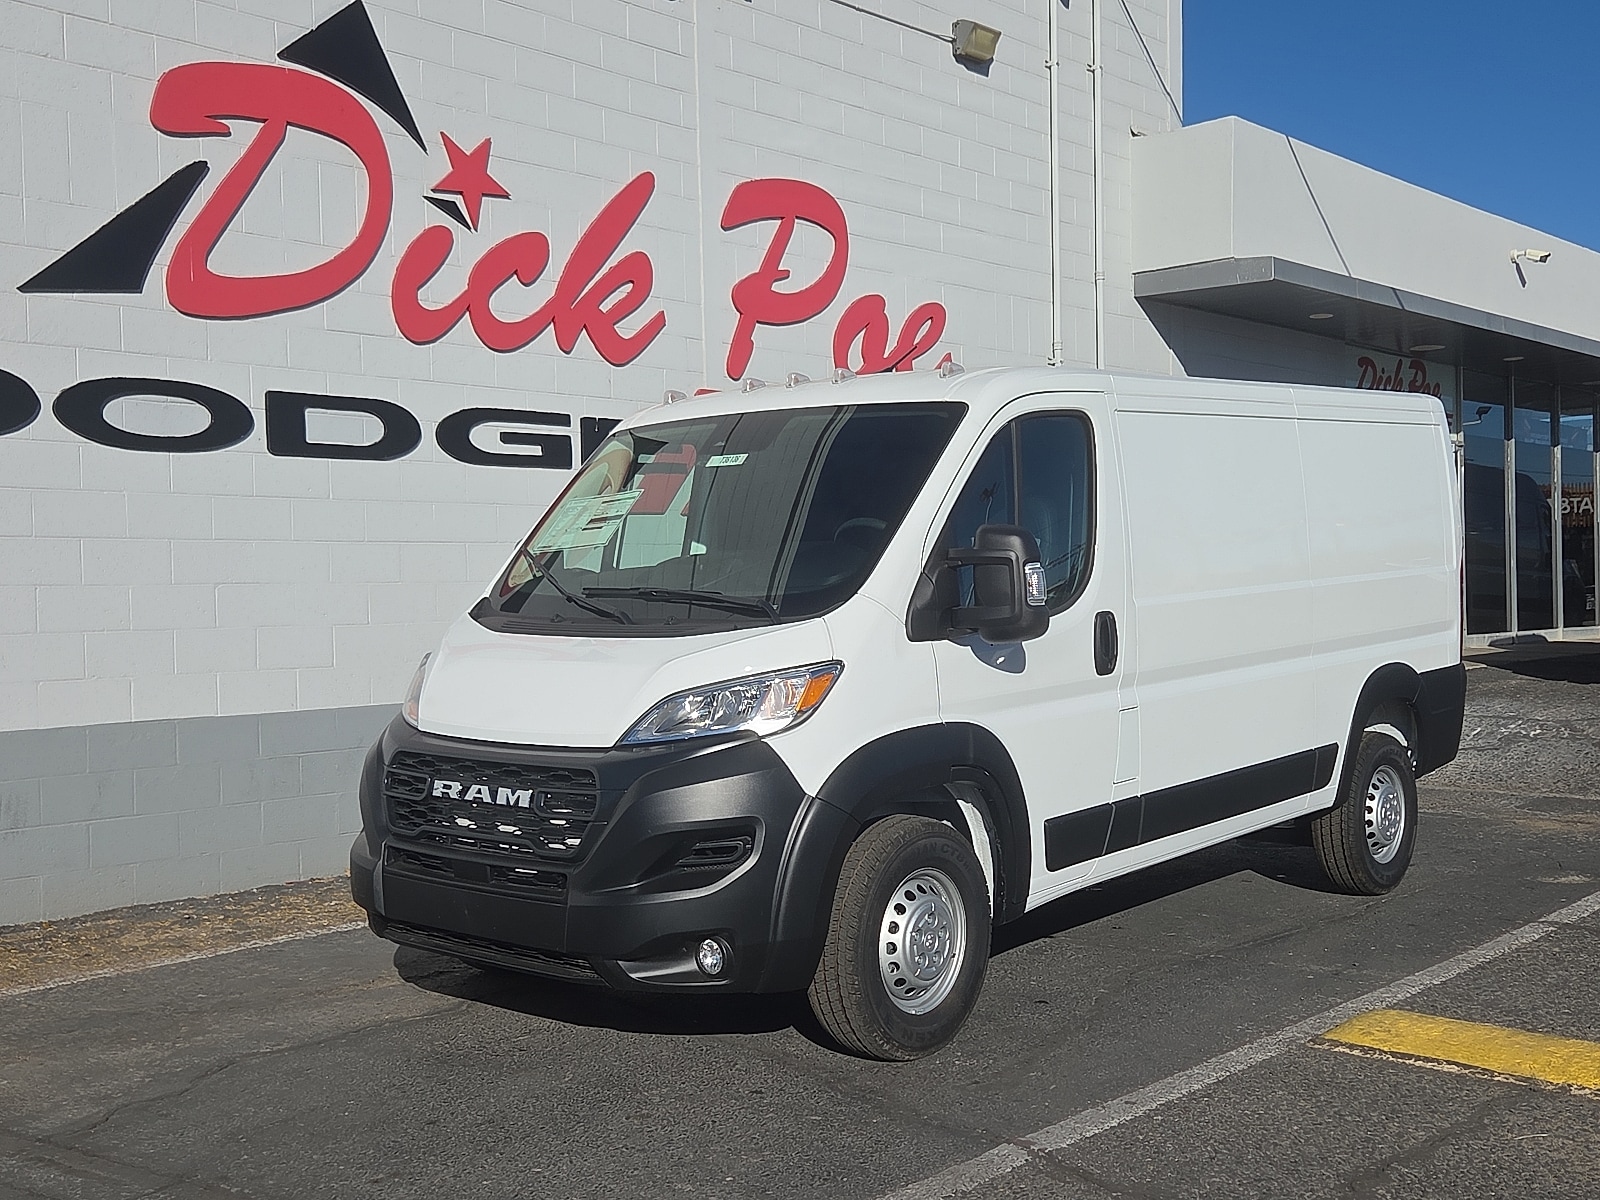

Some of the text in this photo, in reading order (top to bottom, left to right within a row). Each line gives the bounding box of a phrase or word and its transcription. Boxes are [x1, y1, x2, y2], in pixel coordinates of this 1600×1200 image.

[150, 61, 952, 377] Dick Poe
[432, 780, 533, 808] RAM
